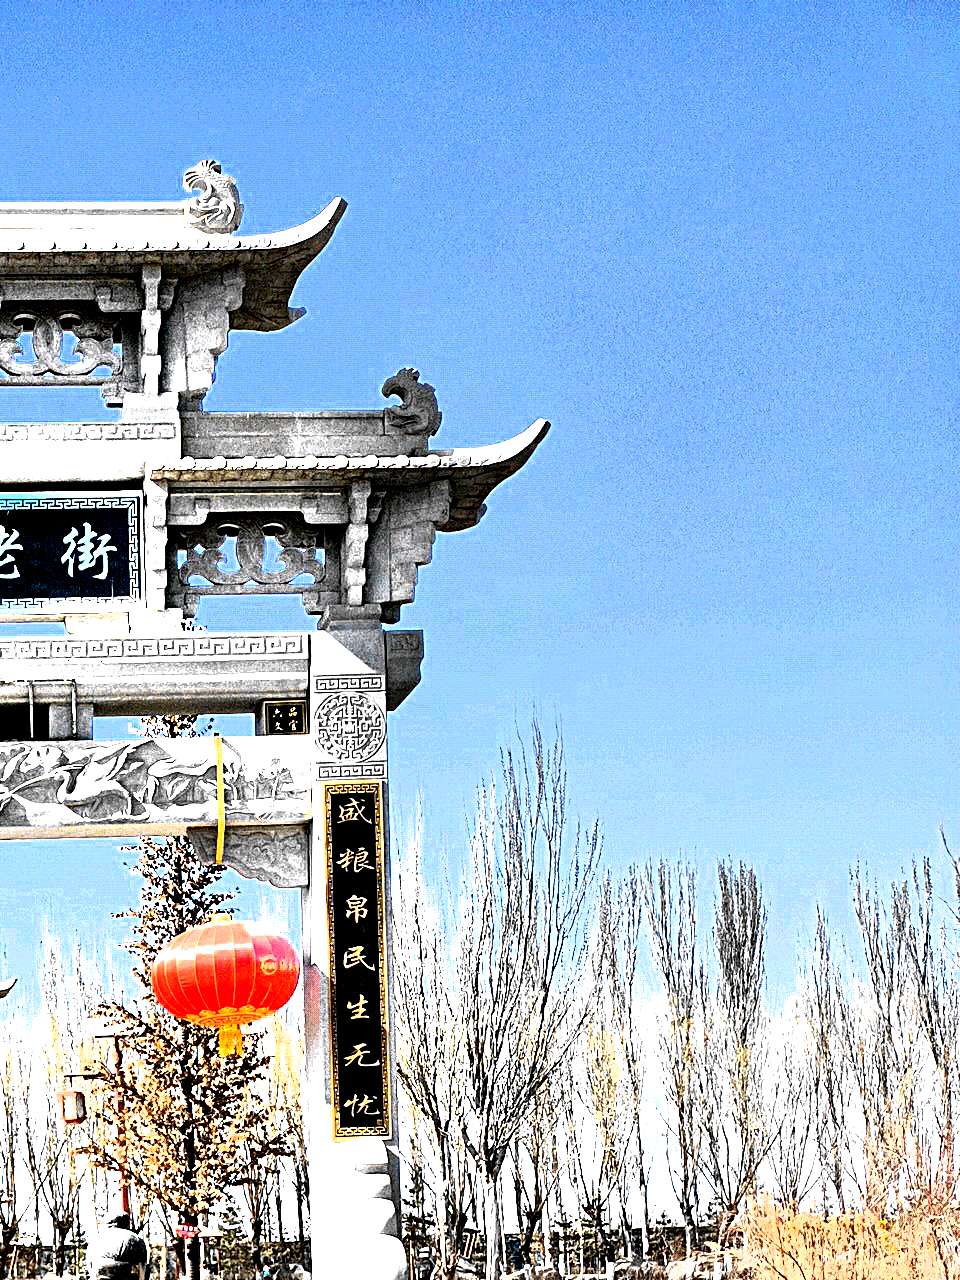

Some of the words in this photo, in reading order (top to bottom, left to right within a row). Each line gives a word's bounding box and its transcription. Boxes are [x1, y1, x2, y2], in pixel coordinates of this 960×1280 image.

[334, 797, 380, 1117] 盛粮帛民生无忧
